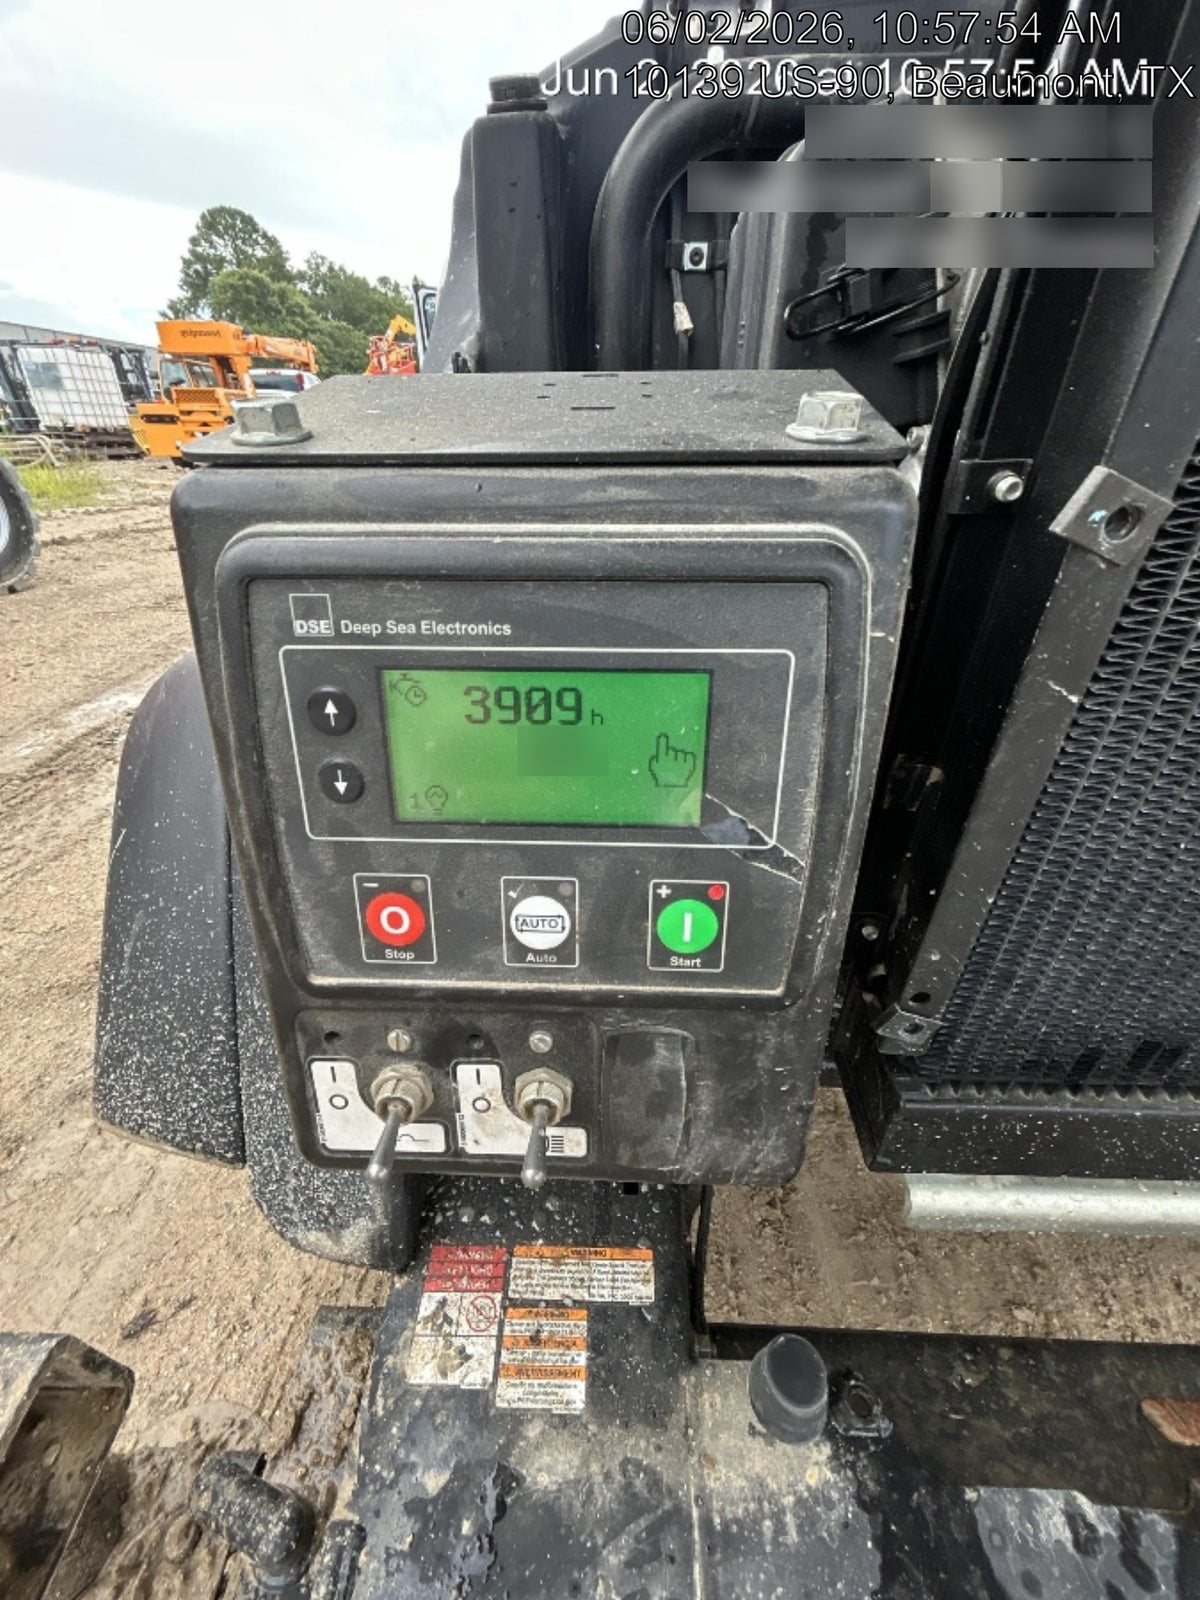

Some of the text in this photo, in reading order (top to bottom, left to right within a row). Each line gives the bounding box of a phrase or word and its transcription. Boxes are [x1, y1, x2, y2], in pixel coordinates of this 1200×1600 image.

[294, 619, 333, 634] DSE
[340, 619, 512, 637] Deep Sea Electronics
[463, 685, 605, 726] 3909 h
[520, 918, 559, 929] AUTO
[384, 948, 415, 962] Stop
[526, 952, 557, 963] Auto
[669, 956, 701, 969] Start
